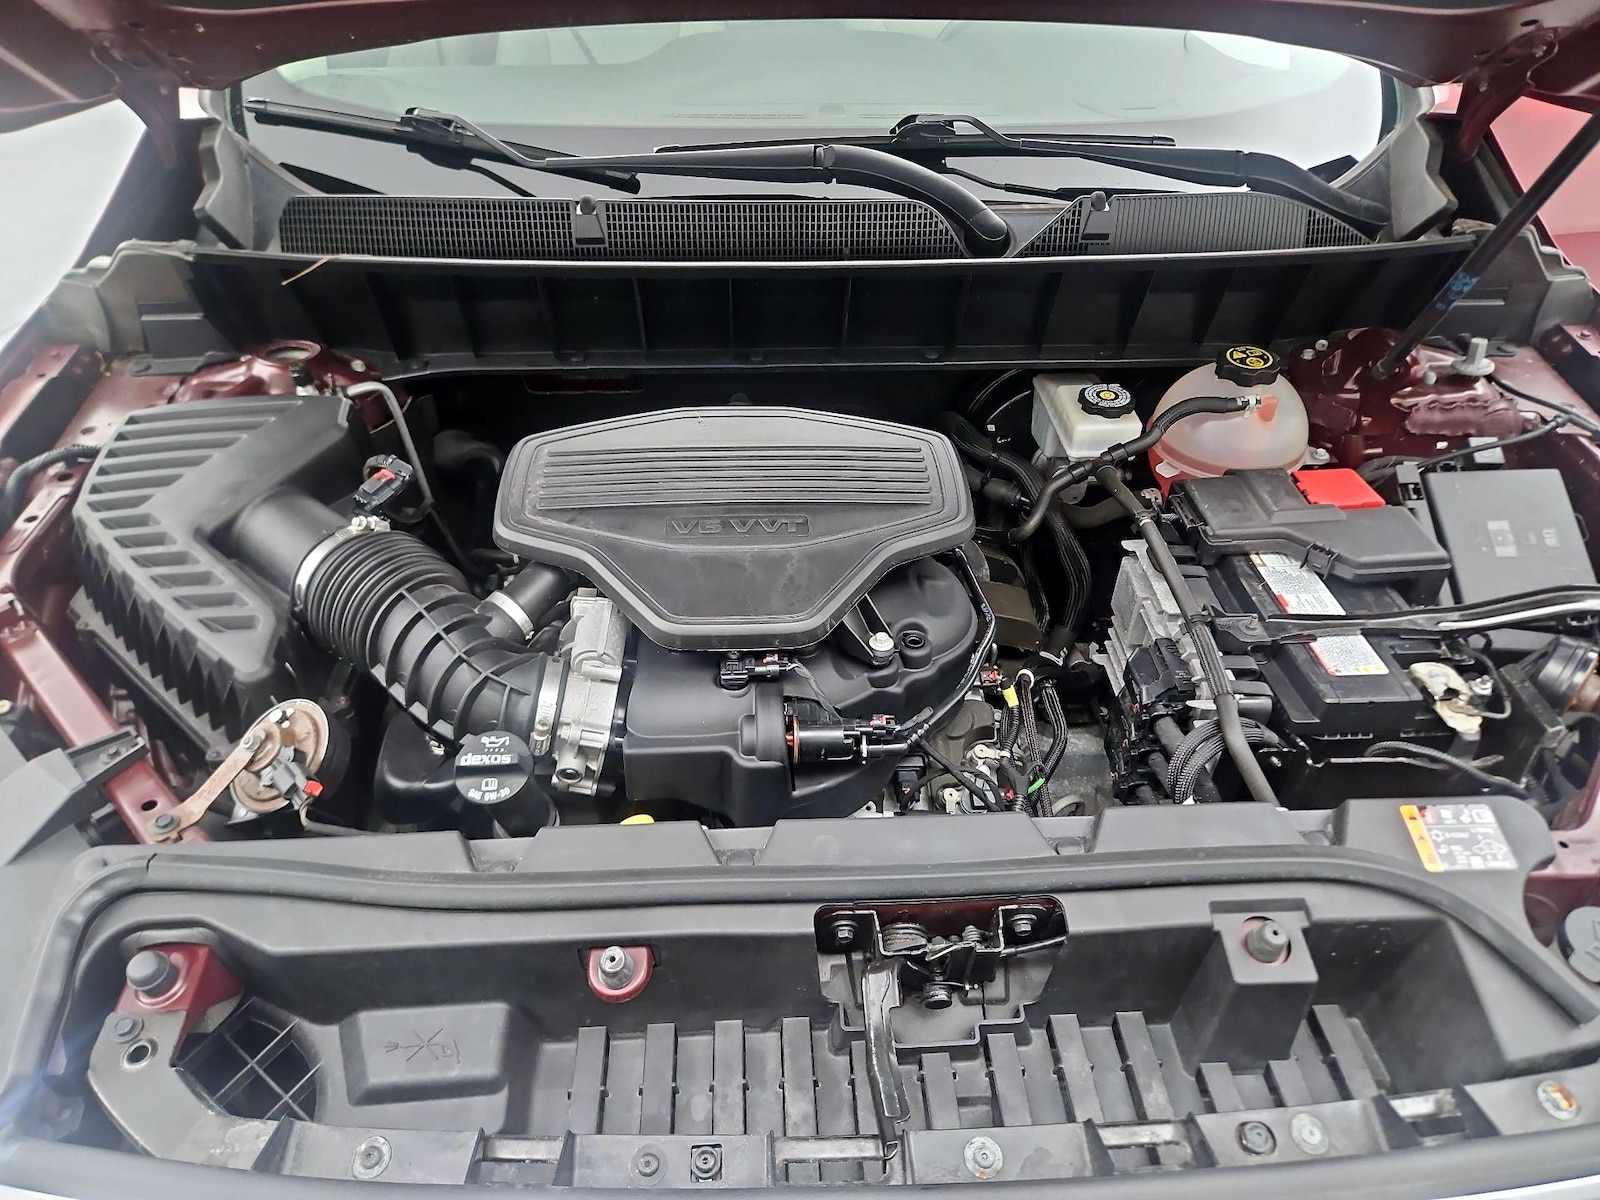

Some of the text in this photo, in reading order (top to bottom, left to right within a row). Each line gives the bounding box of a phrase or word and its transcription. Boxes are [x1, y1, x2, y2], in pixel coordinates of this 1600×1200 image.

[671, 518, 803, 534] V6 VVT
[460, 753, 512, 766] dexos
